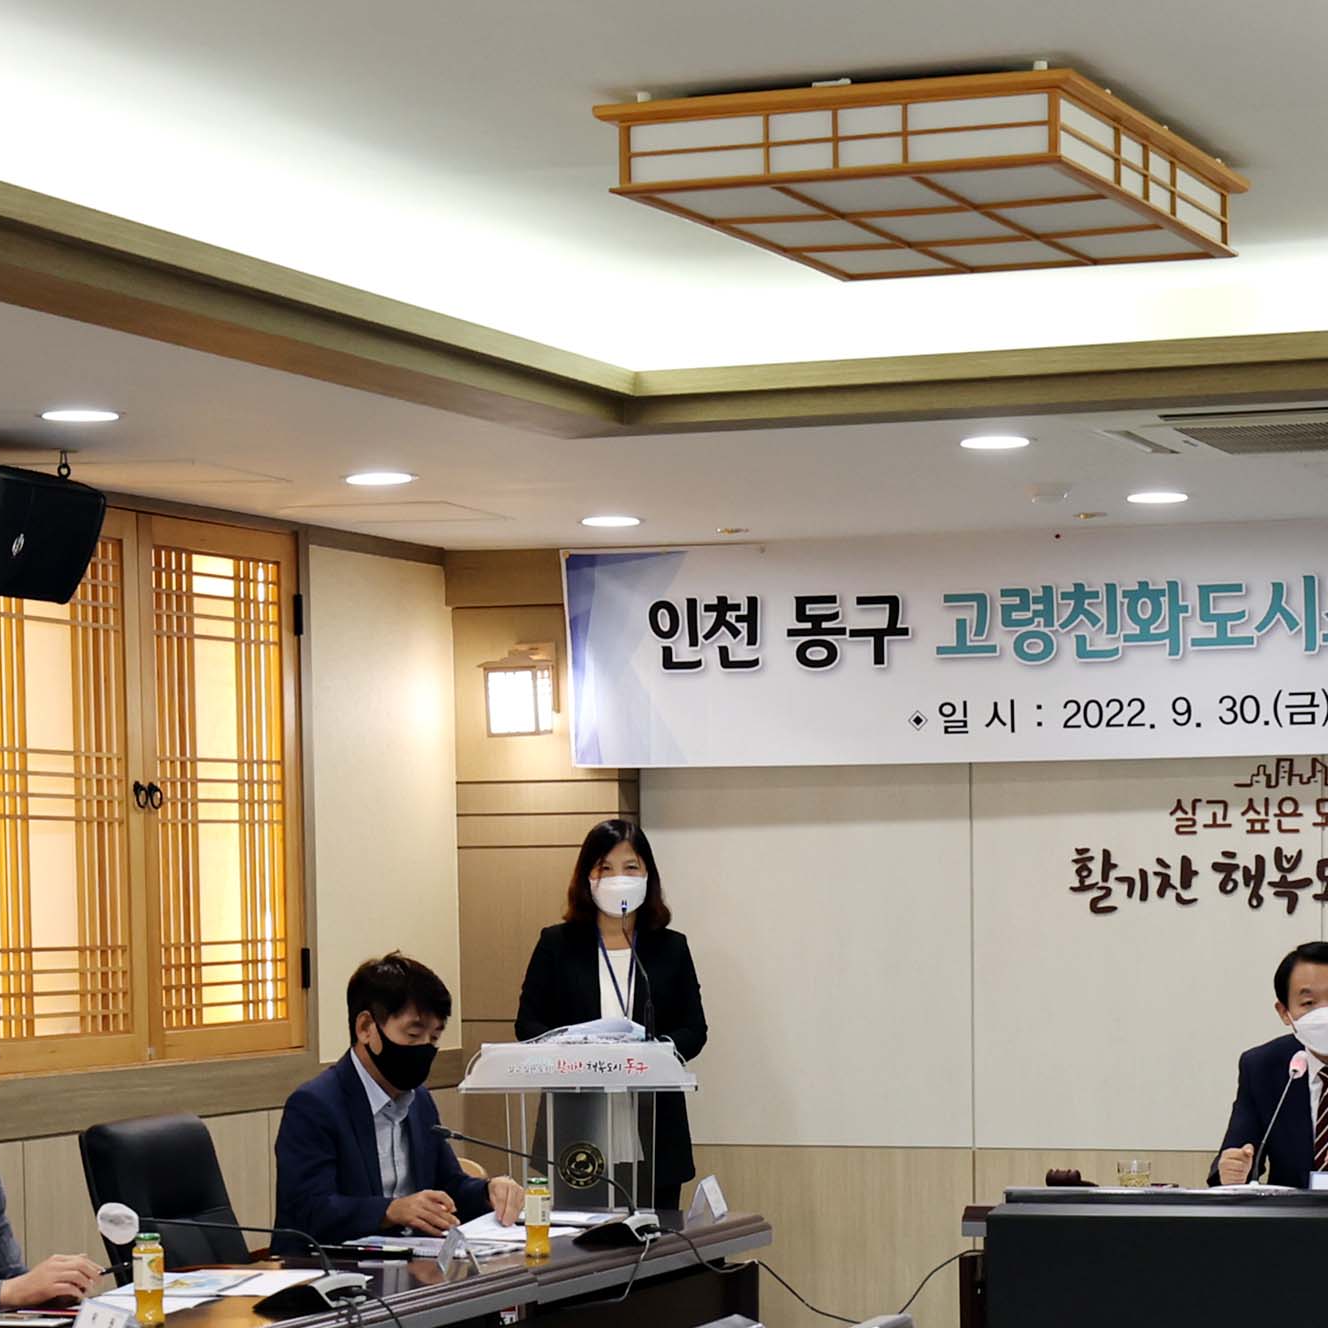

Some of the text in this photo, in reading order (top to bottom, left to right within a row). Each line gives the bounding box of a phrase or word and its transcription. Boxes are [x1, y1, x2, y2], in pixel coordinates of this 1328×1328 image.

[648, 596, 761, 670] 인천
[786, 593, 910, 668] 동구
[1062, 698, 1156, 730] 2022.
[1171, 697, 1202, 728] 9.
[1170, 798, 1232, 835] 살고
[1240, 796, 1303, 833] 싶은
[1070, 847, 1198, 914] 활기찬
